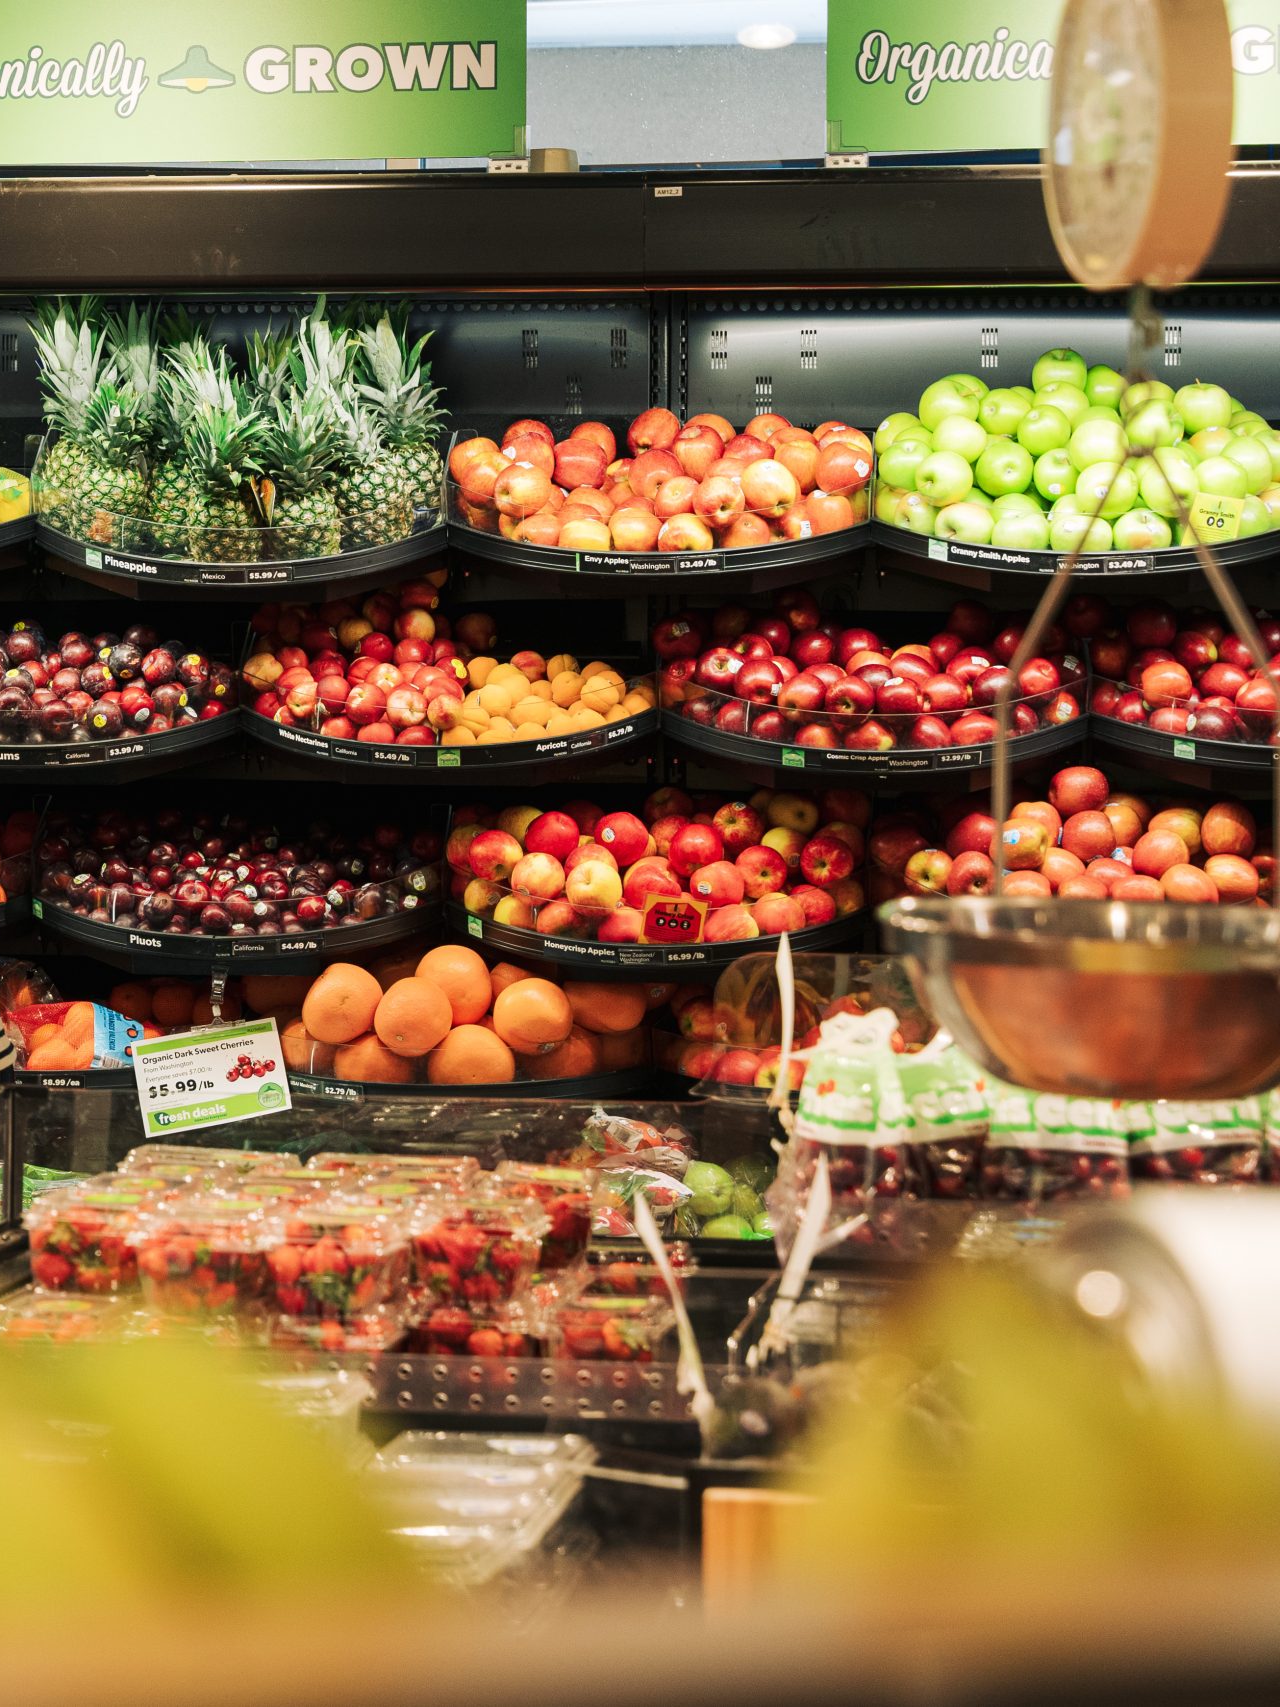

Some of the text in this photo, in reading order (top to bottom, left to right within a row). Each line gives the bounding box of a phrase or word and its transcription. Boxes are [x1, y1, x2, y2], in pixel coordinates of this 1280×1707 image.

[243, 41, 498, 93] GROWN
[584, 555, 603, 565] Envy
[603, 556, 629, 566] Apples
[630, 562, 670, 571] Washington
[950, 546, 978, 559] Granny
[978, 549, 1000, 561] Smith
[1001, 553, 1031, 565] Apples
[105, 555, 158, 574] Pineapples
[202, 572, 226, 580] Mexico
[279, 728, 295, 741] White
[295, 732, 329, 749] Nectarines
[335, 747, 358, 756] California
[536, 740, 567, 752] Apricots
[570, 740, 592, 749] California
[65, 751, 90, 759] California
[889, 759, 928, 767] Washington
[129, 934, 162, 949] Pluots
[233, 944, 264, 952] California
[544, 940, 587, 954] Honeycrisp
[587, 947, 615, 957] Apples
[142, 1038, 254, 1065] Organic Dark Sweet Cherries
[143, 1060, 194, 1074] From Washington
[145, 1073, 173, 1084] Everyone
[174, 1071, 188, 1079] saves
[158, 1109, 190, 1126] fresh
[192, 1103, 226, 1118] deals
